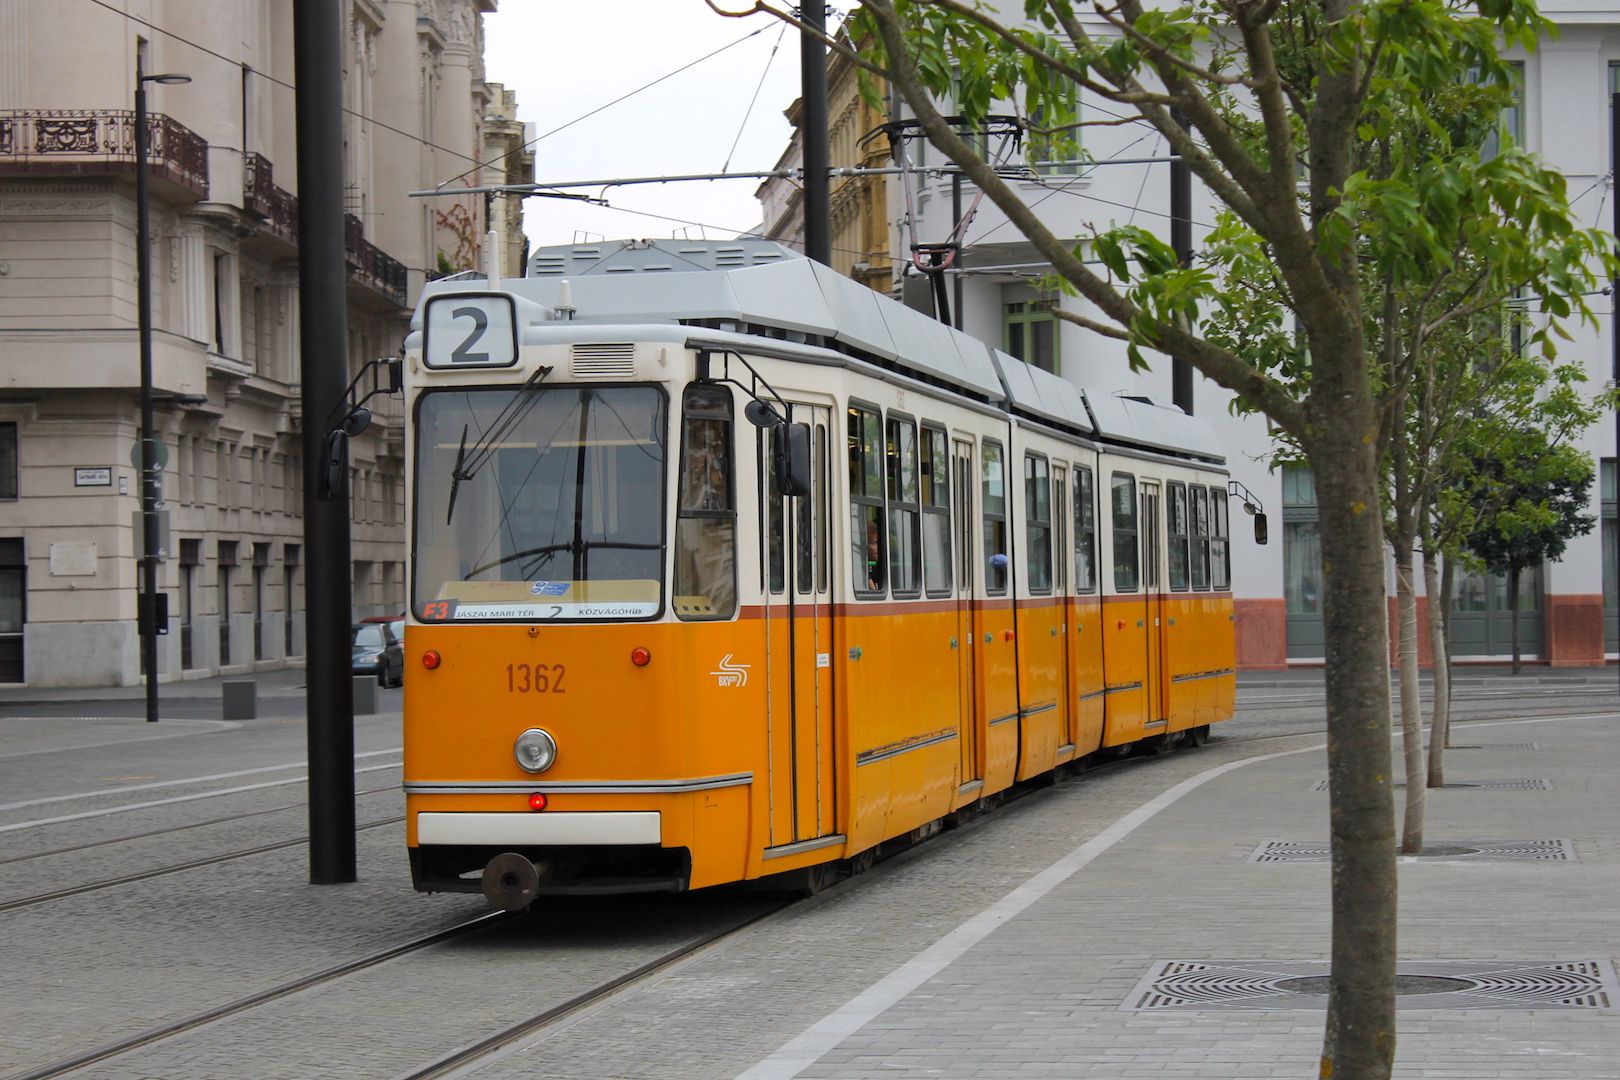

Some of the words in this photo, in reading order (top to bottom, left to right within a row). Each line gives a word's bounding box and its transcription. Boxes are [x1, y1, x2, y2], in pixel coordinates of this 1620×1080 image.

[451, 306, 489, 363] 2
[423, 601, 449, 620] F3
[456, 609, 487, 618] JÁSZAI
[489, 610, 515, 618] MARI
[516, 608, 535, 617] TÉR
[550, 605, 563, 619] 2
[578, 607, 642, 616] KÖZVÁGÓHÍD
[506, 663, 566, 694] 1362
